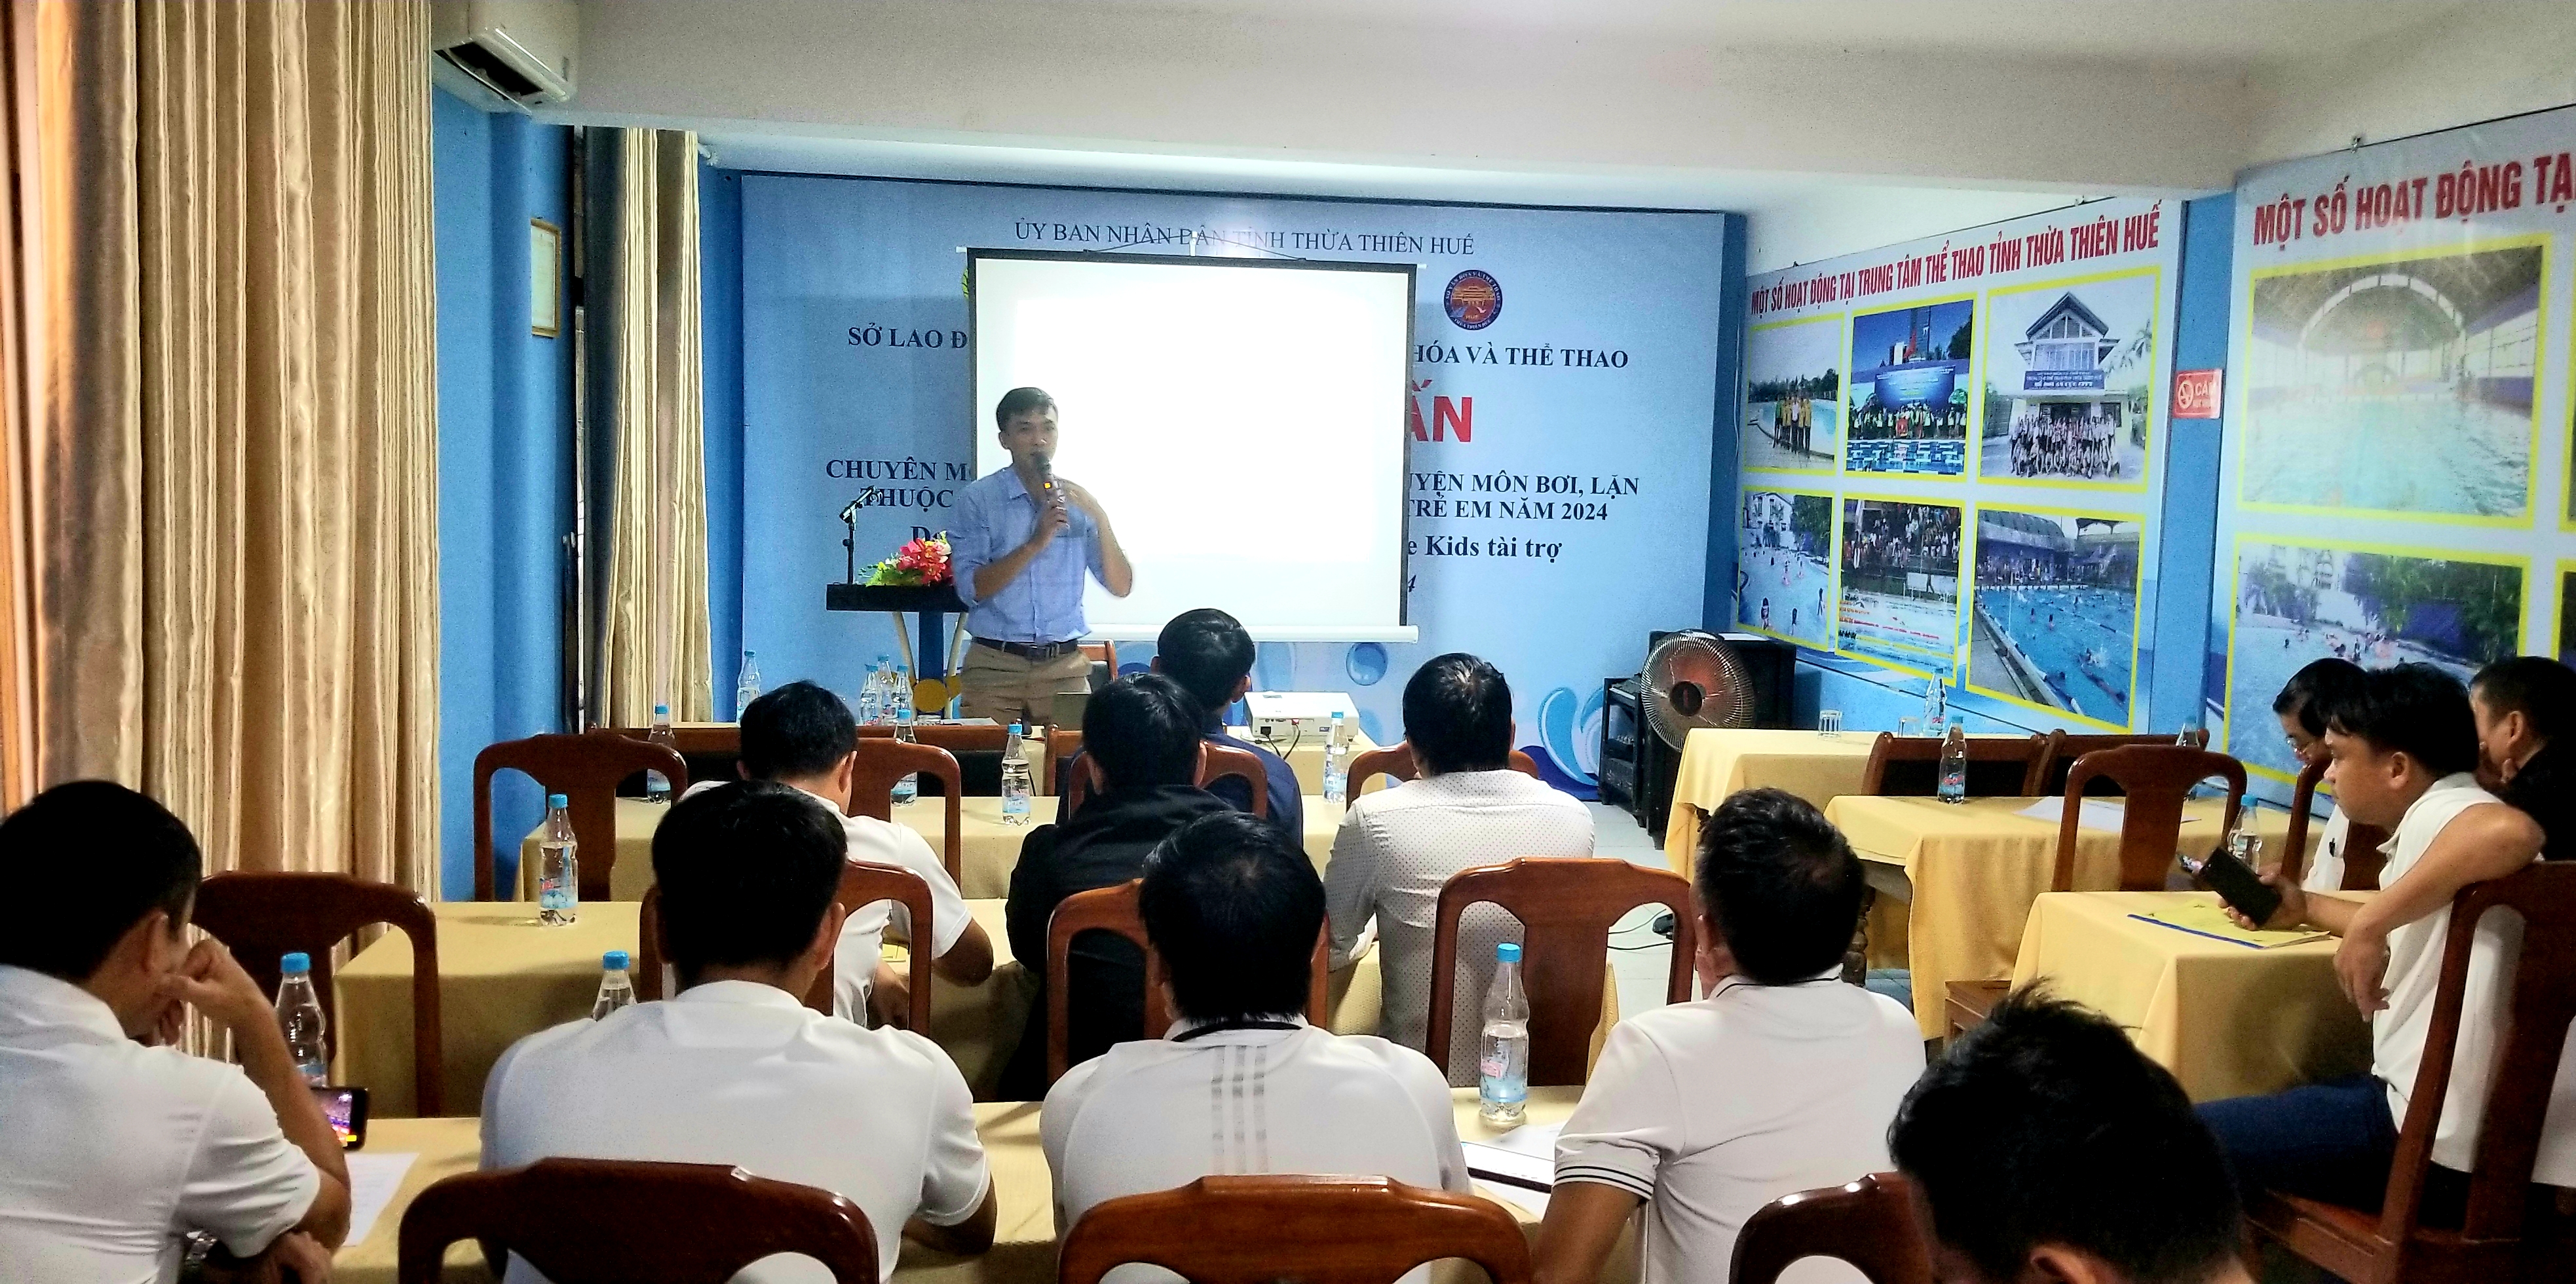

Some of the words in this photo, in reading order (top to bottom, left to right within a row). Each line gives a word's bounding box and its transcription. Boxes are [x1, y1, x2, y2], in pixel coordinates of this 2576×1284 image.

[2253, 193, 2307, 251] MỘT
[2313, 175, 2349, 238] SỐ
[2356, 176, 2429, 234] HOẠT
[2435, 159, 2522, 223] ĐỘNG
[2533, 153, 2576, 213] TẠ
[1015, 217, 1046, 240] ỦY
[1053, 224, 1100, 242] BAN
[1107, 223, 1171, 245] NHÂN
[1233, 226, 1284, 248] TỈNH
[1291, 229, 1354, 251] THỪA
[1358, 231, 1424, 254] THIÊN
[1430, 233, 1474, 255] HUẾ
[1751, 285, 1770, 318] MỘT
[1771, 276, 1785, 312] SỐ
[1785, 280, 1809, 313] HOẠT
[1809, 273, 1836, 310] ĐỘNG
[1839, 271, 1855, 305] TẠI
[1858, 263, 1893, 297] TRUNG
[1897, 254, 1922, 290] TÂM
[1925, 239, 1950, 284] THỂ
[1952, 244, 1984, 280] THAO
[1989, 230, 2022, 274] TỈNH
[2026, 225, 2064, 268] THỪA
[2070, 214, 2119, 261] THIÊN
[2123, 198, 2162, 252] HUẾ
[848, 322, 882, 346] SỞ
[888, 328, 943, 349] LAO
[951, 330, 968, 349] Đ
[1465, 341, 1499, 365] VÀ
[1560, 349, 1629, 368] THAO
[826, 456, 937, 480] CHUYÊN
[945, 462, 972, 481] M
[1409, 470, 1464, 497] YỆN
[1471, 470, 1528, 493] MÔN
[1536, 475, 1583, 498] BƠI,
[1590, 475, 1640, 500] LẶN
[860, 486, 954, 512] THUỘC
[1454, 500, 1492, 519] EM
[1498, 497, 1555, 519] NĂM
[1561, 502, 1608, 521] 2024
[1409, 540, 1417, 555] e
[1425, 535, 1479, 556] Kids
[1488, 537, 1517, 557] tài
[1525, 538, 1563, 563] trợ
[1408, 575, 1416, 592] 4
